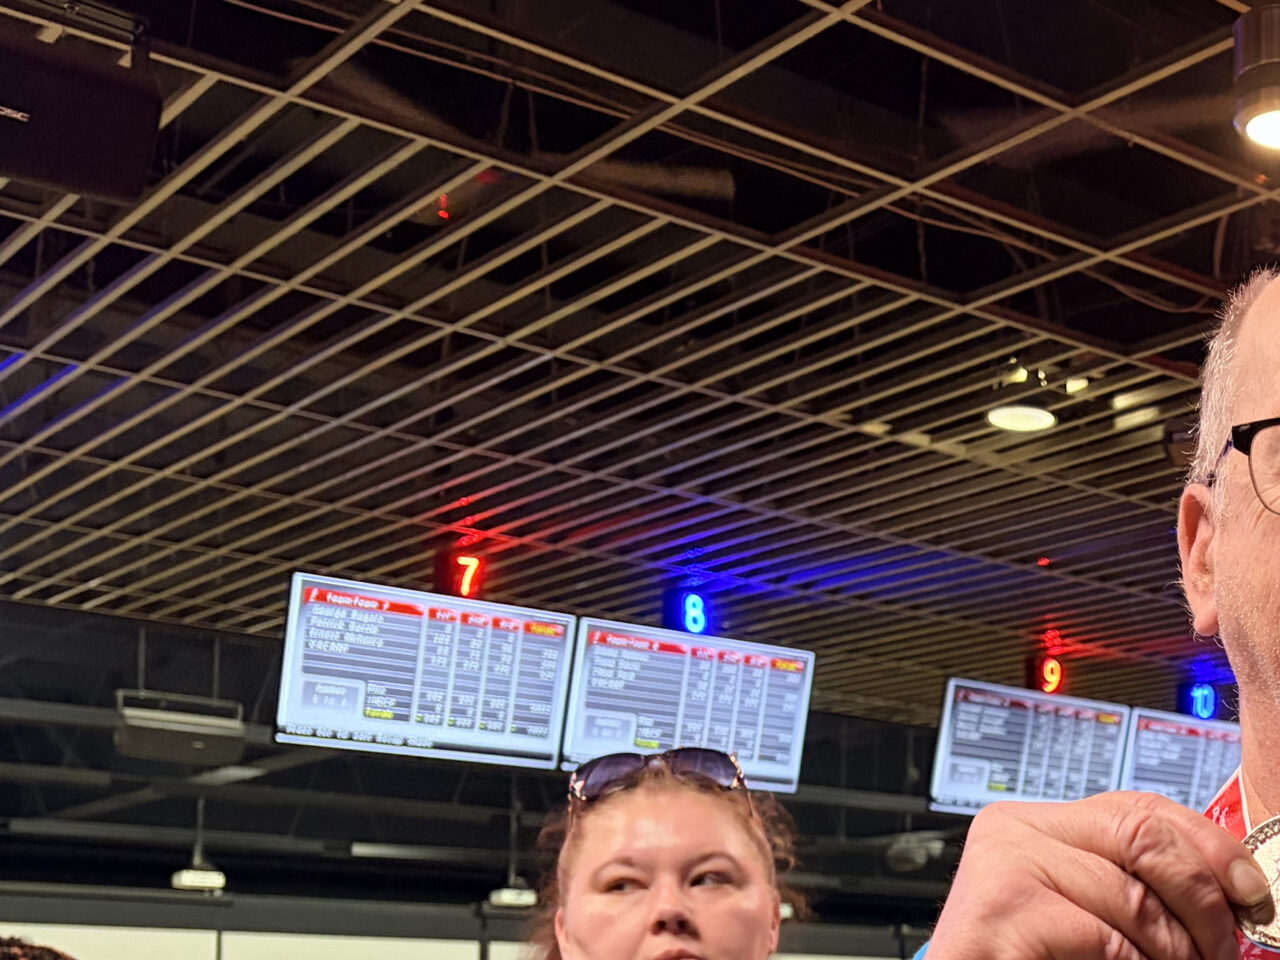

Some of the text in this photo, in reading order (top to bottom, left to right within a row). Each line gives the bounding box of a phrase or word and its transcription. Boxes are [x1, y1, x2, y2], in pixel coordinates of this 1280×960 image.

[457, 556, 480, 597] 7
[684, 593, 704, 634] 8
[1042, 657, 1063, 694] 9
